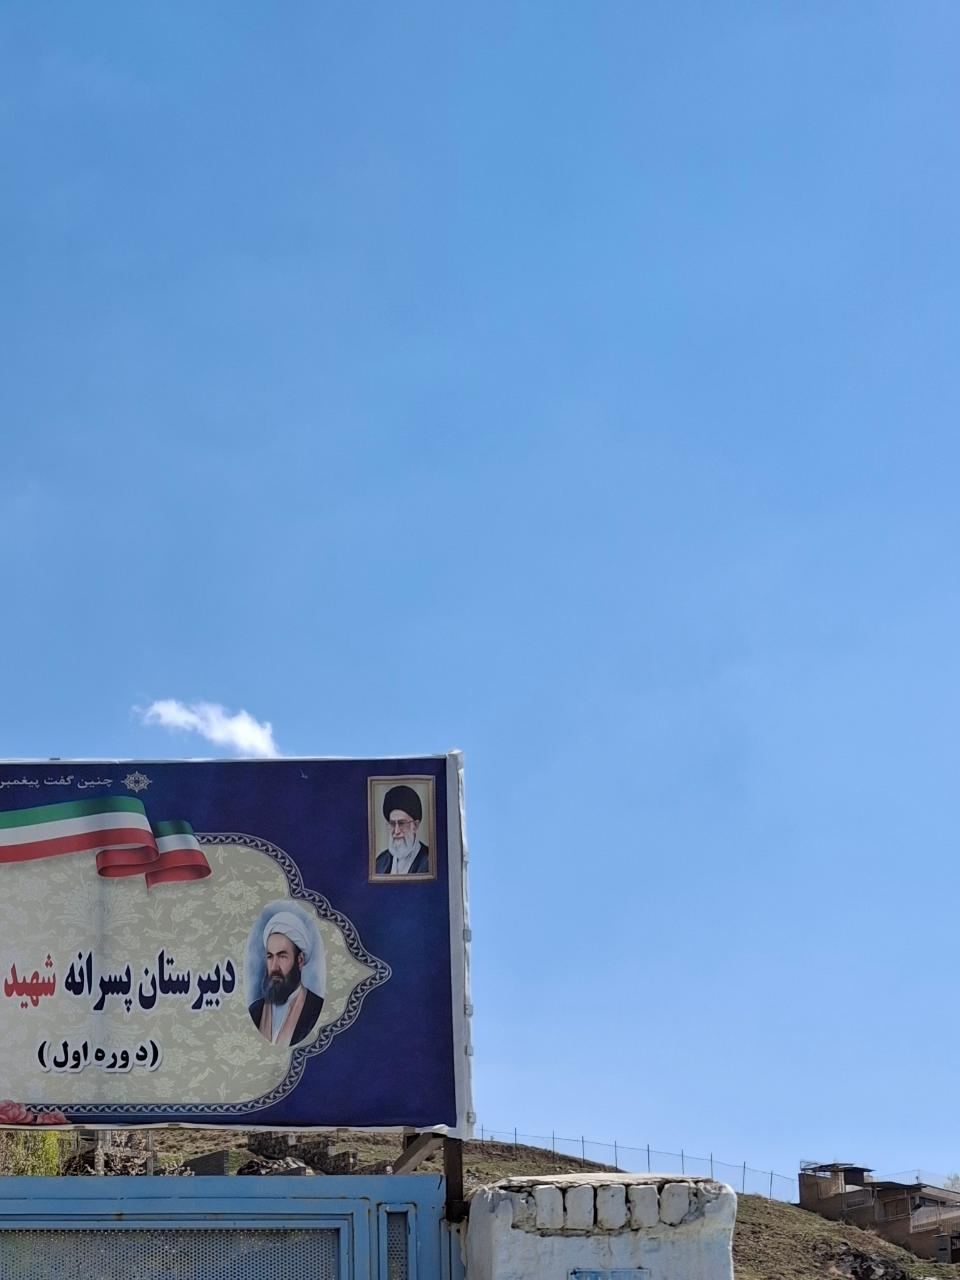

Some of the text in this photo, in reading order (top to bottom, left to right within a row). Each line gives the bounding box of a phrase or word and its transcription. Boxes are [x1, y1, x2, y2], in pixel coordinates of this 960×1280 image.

[43, 775, 74, 786] گفت
[77, 776, 113, 789] چنین
[3, 953, 56, 1009] شهید
[64, 951, 132, 1013] پسرانه
[138, 949, 236, 1010] دبیرستان
